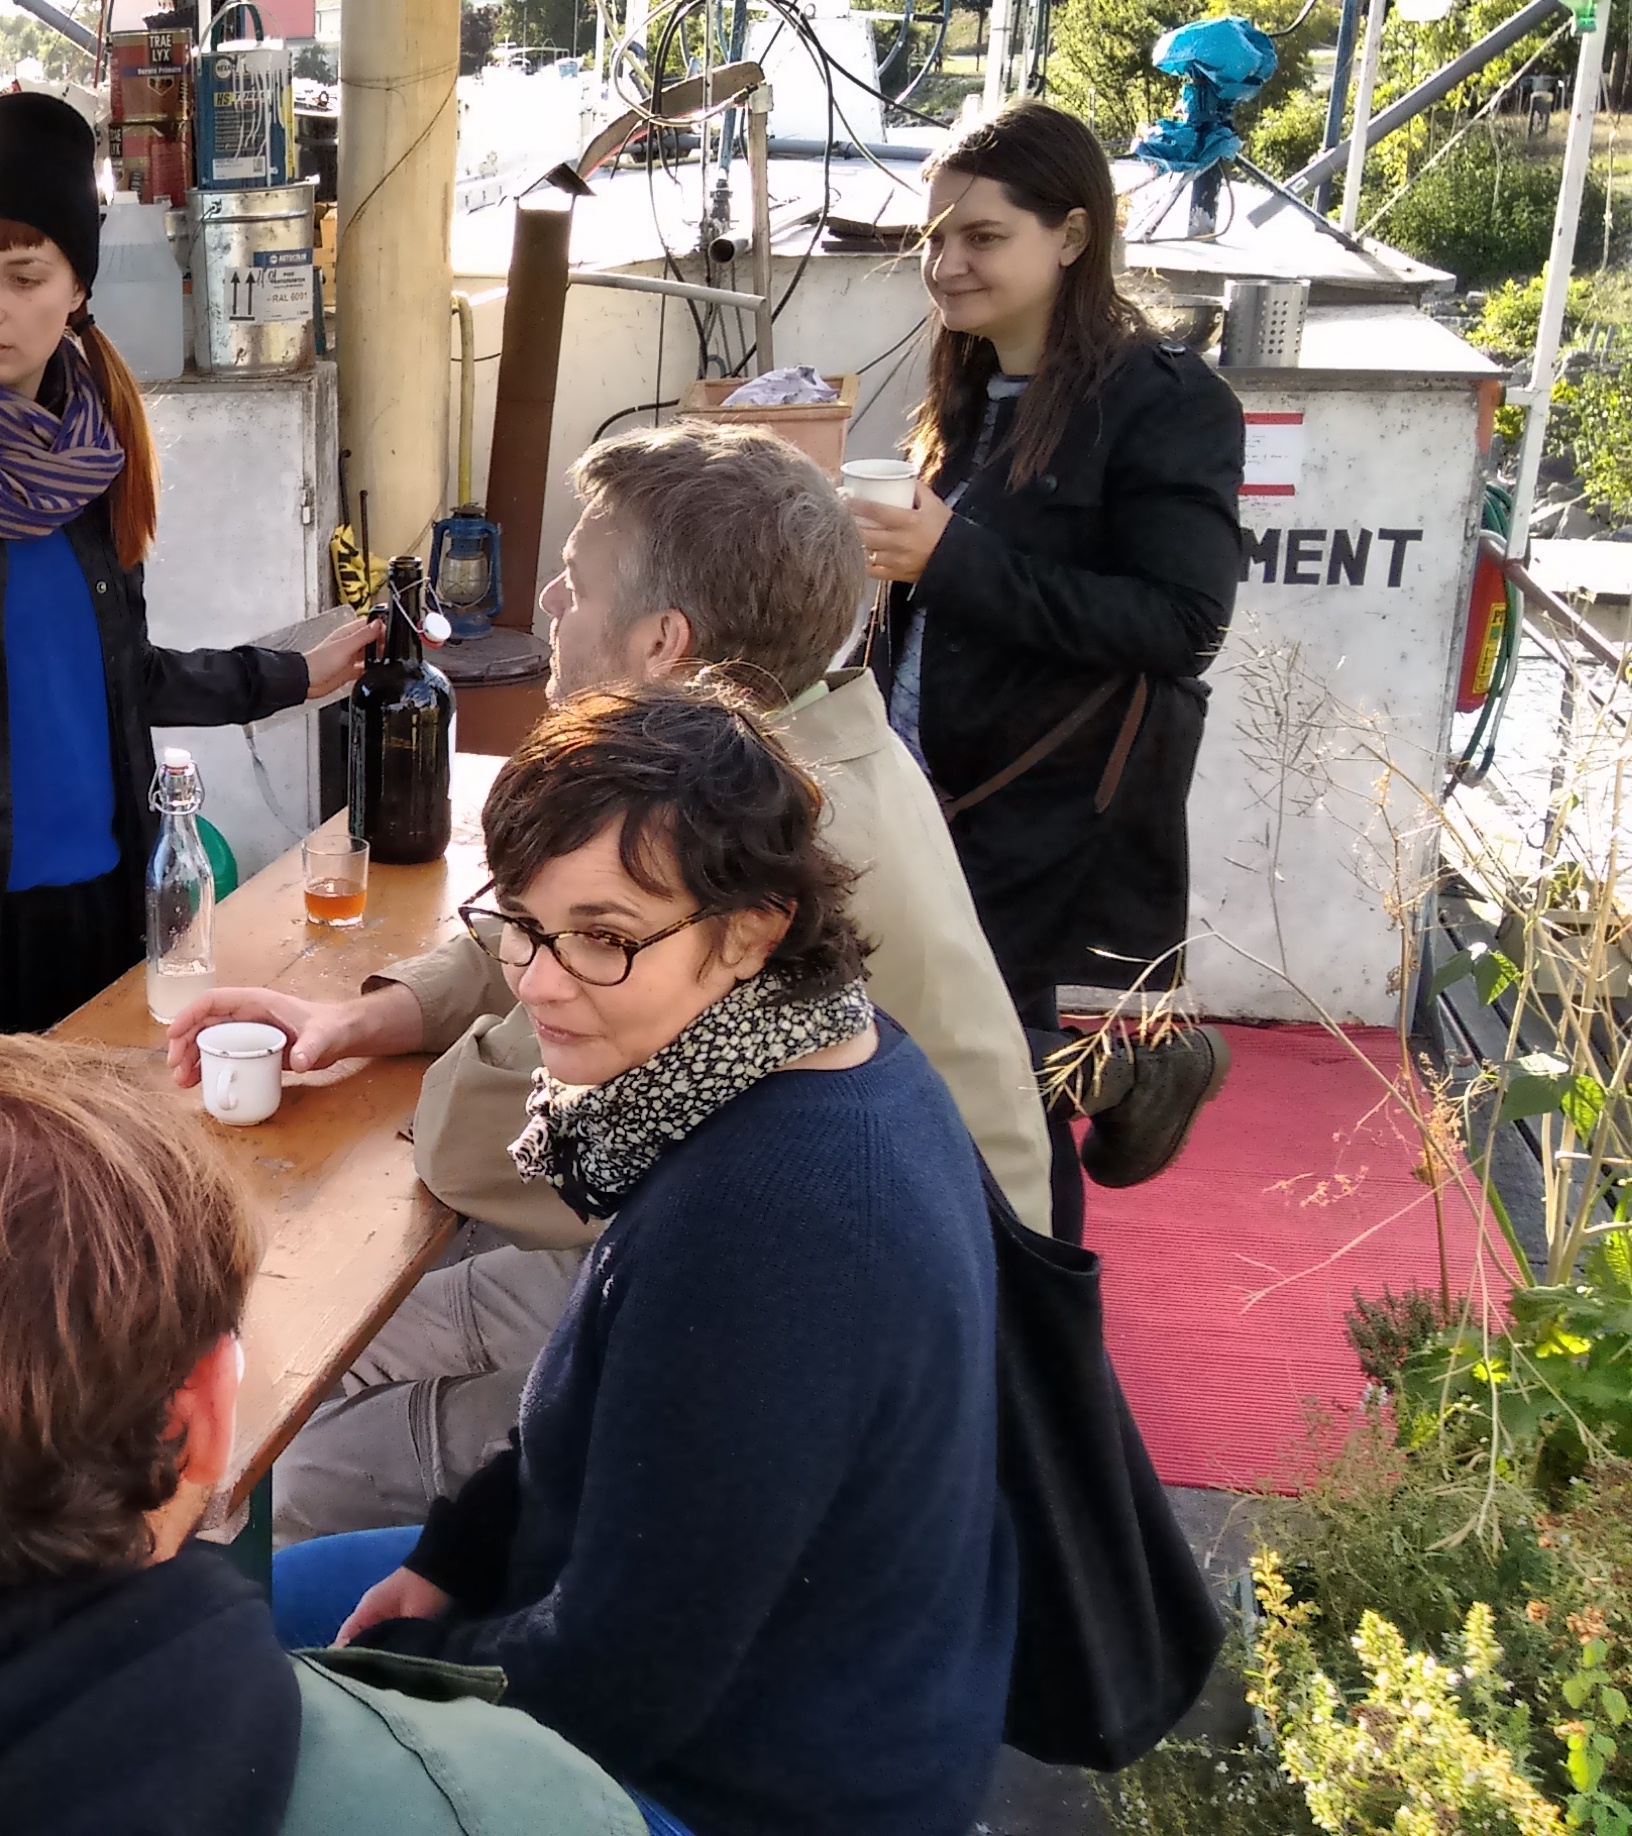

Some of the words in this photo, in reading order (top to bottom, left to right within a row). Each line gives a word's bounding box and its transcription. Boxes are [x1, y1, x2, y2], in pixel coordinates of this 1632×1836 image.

[149, 34, 172, 48] TRAE
[152, 48, 170, 62] LYX
[216, 93, 231, 106] HS
[1239, 527, 1423, 587] MENT
